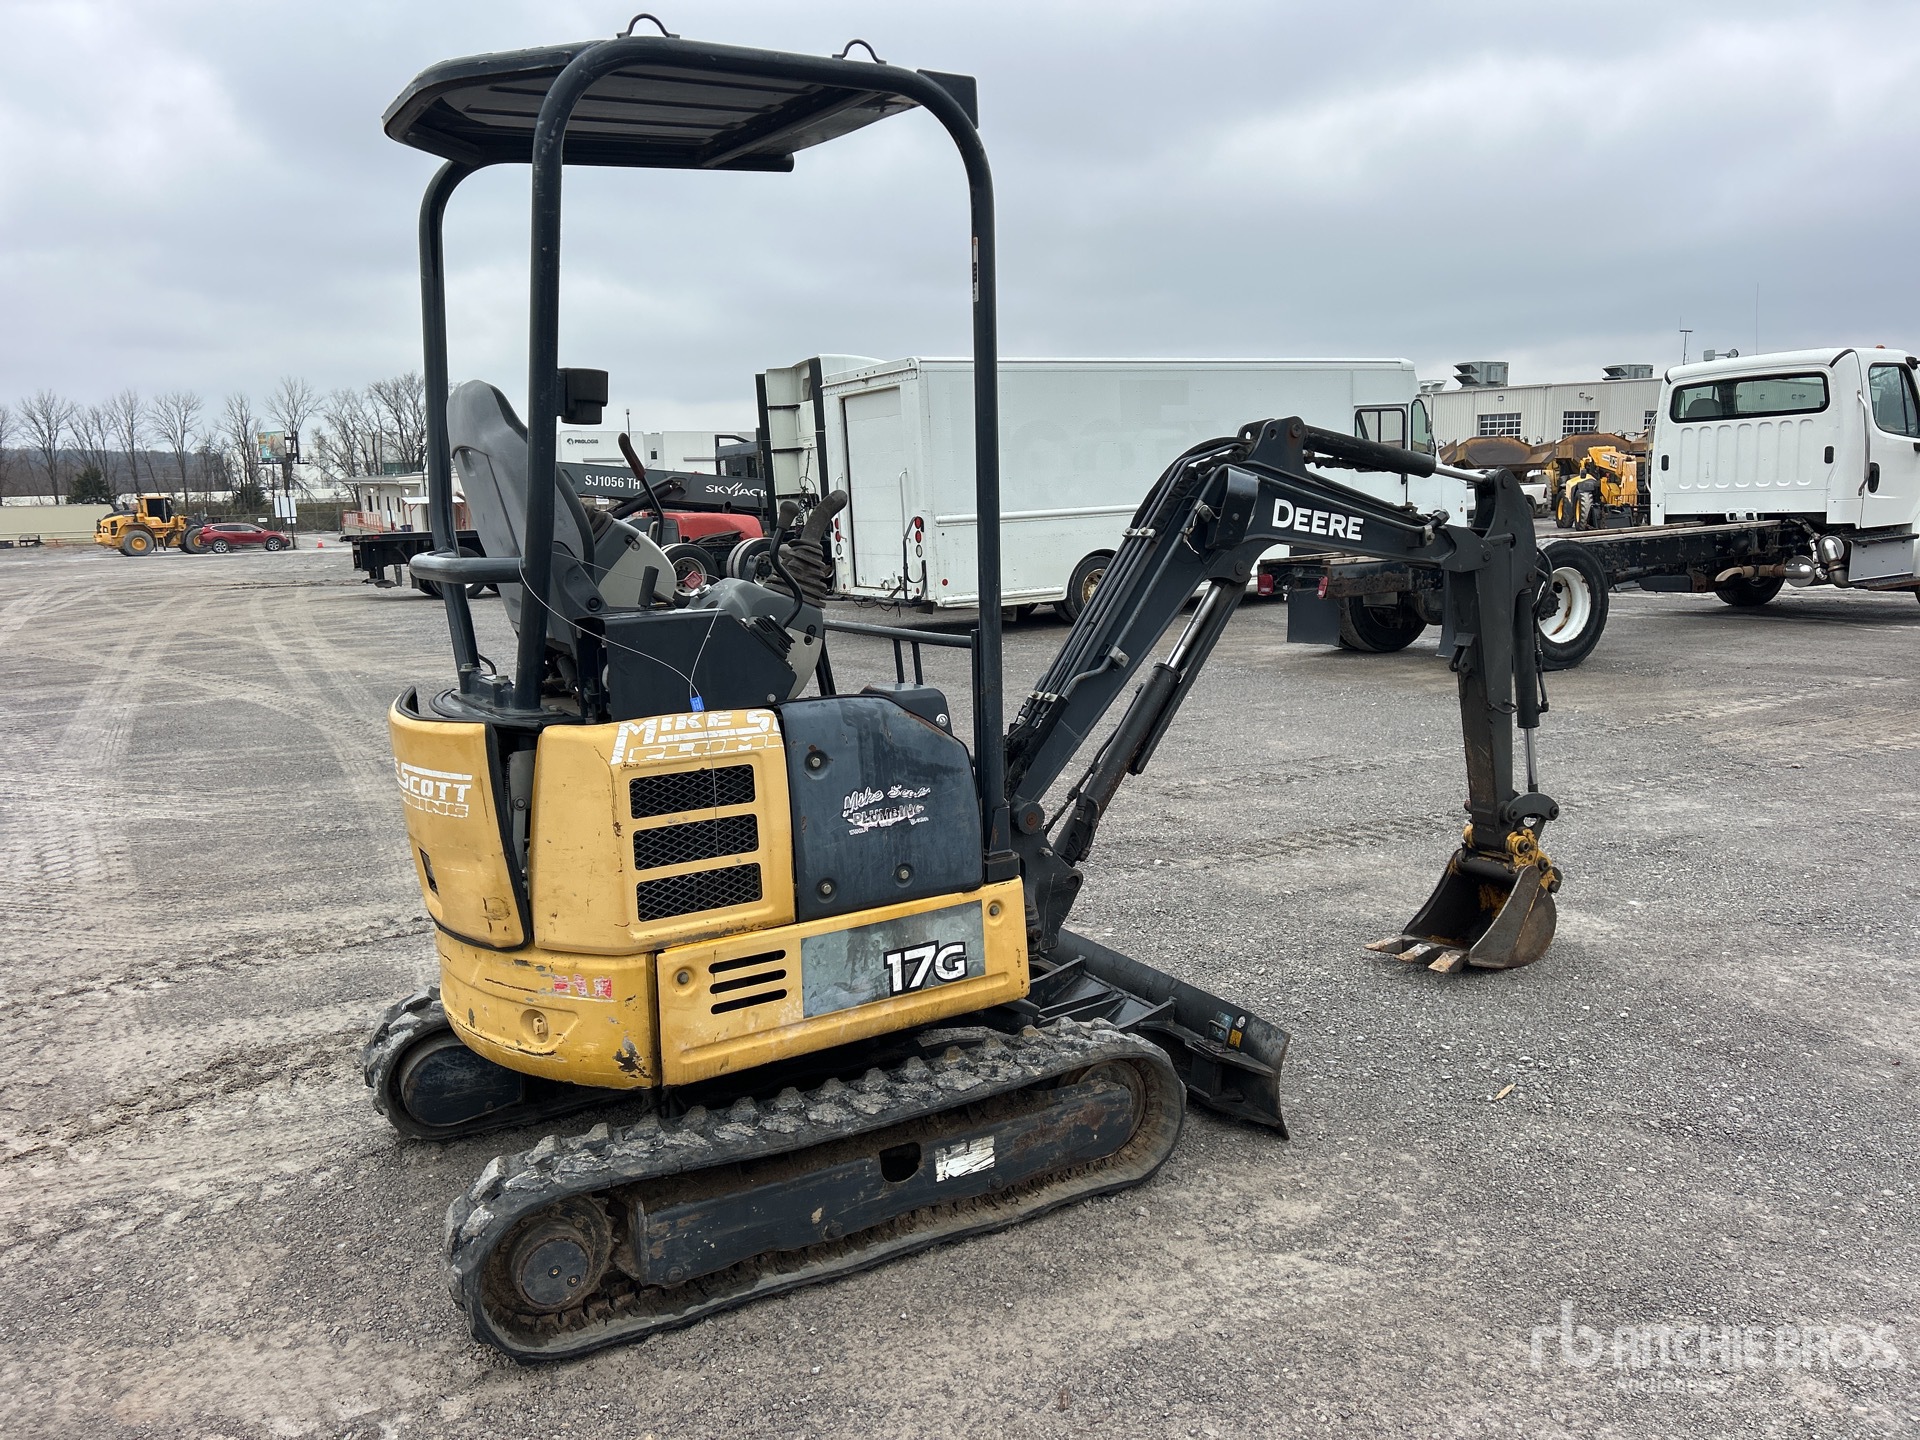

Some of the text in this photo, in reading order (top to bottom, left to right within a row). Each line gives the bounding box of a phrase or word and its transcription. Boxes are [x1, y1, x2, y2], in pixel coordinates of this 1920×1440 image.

[584, 475, 641, 490] SJ1056 TH
[705, 482, 767, 497] SKYJACK
[1271, 498, 1364, 541] DEERE
[610, 711, 733, 765] MIKE
[397, 762, 472, 802] SCOTT
[884, 941, 967, 995] 17G
